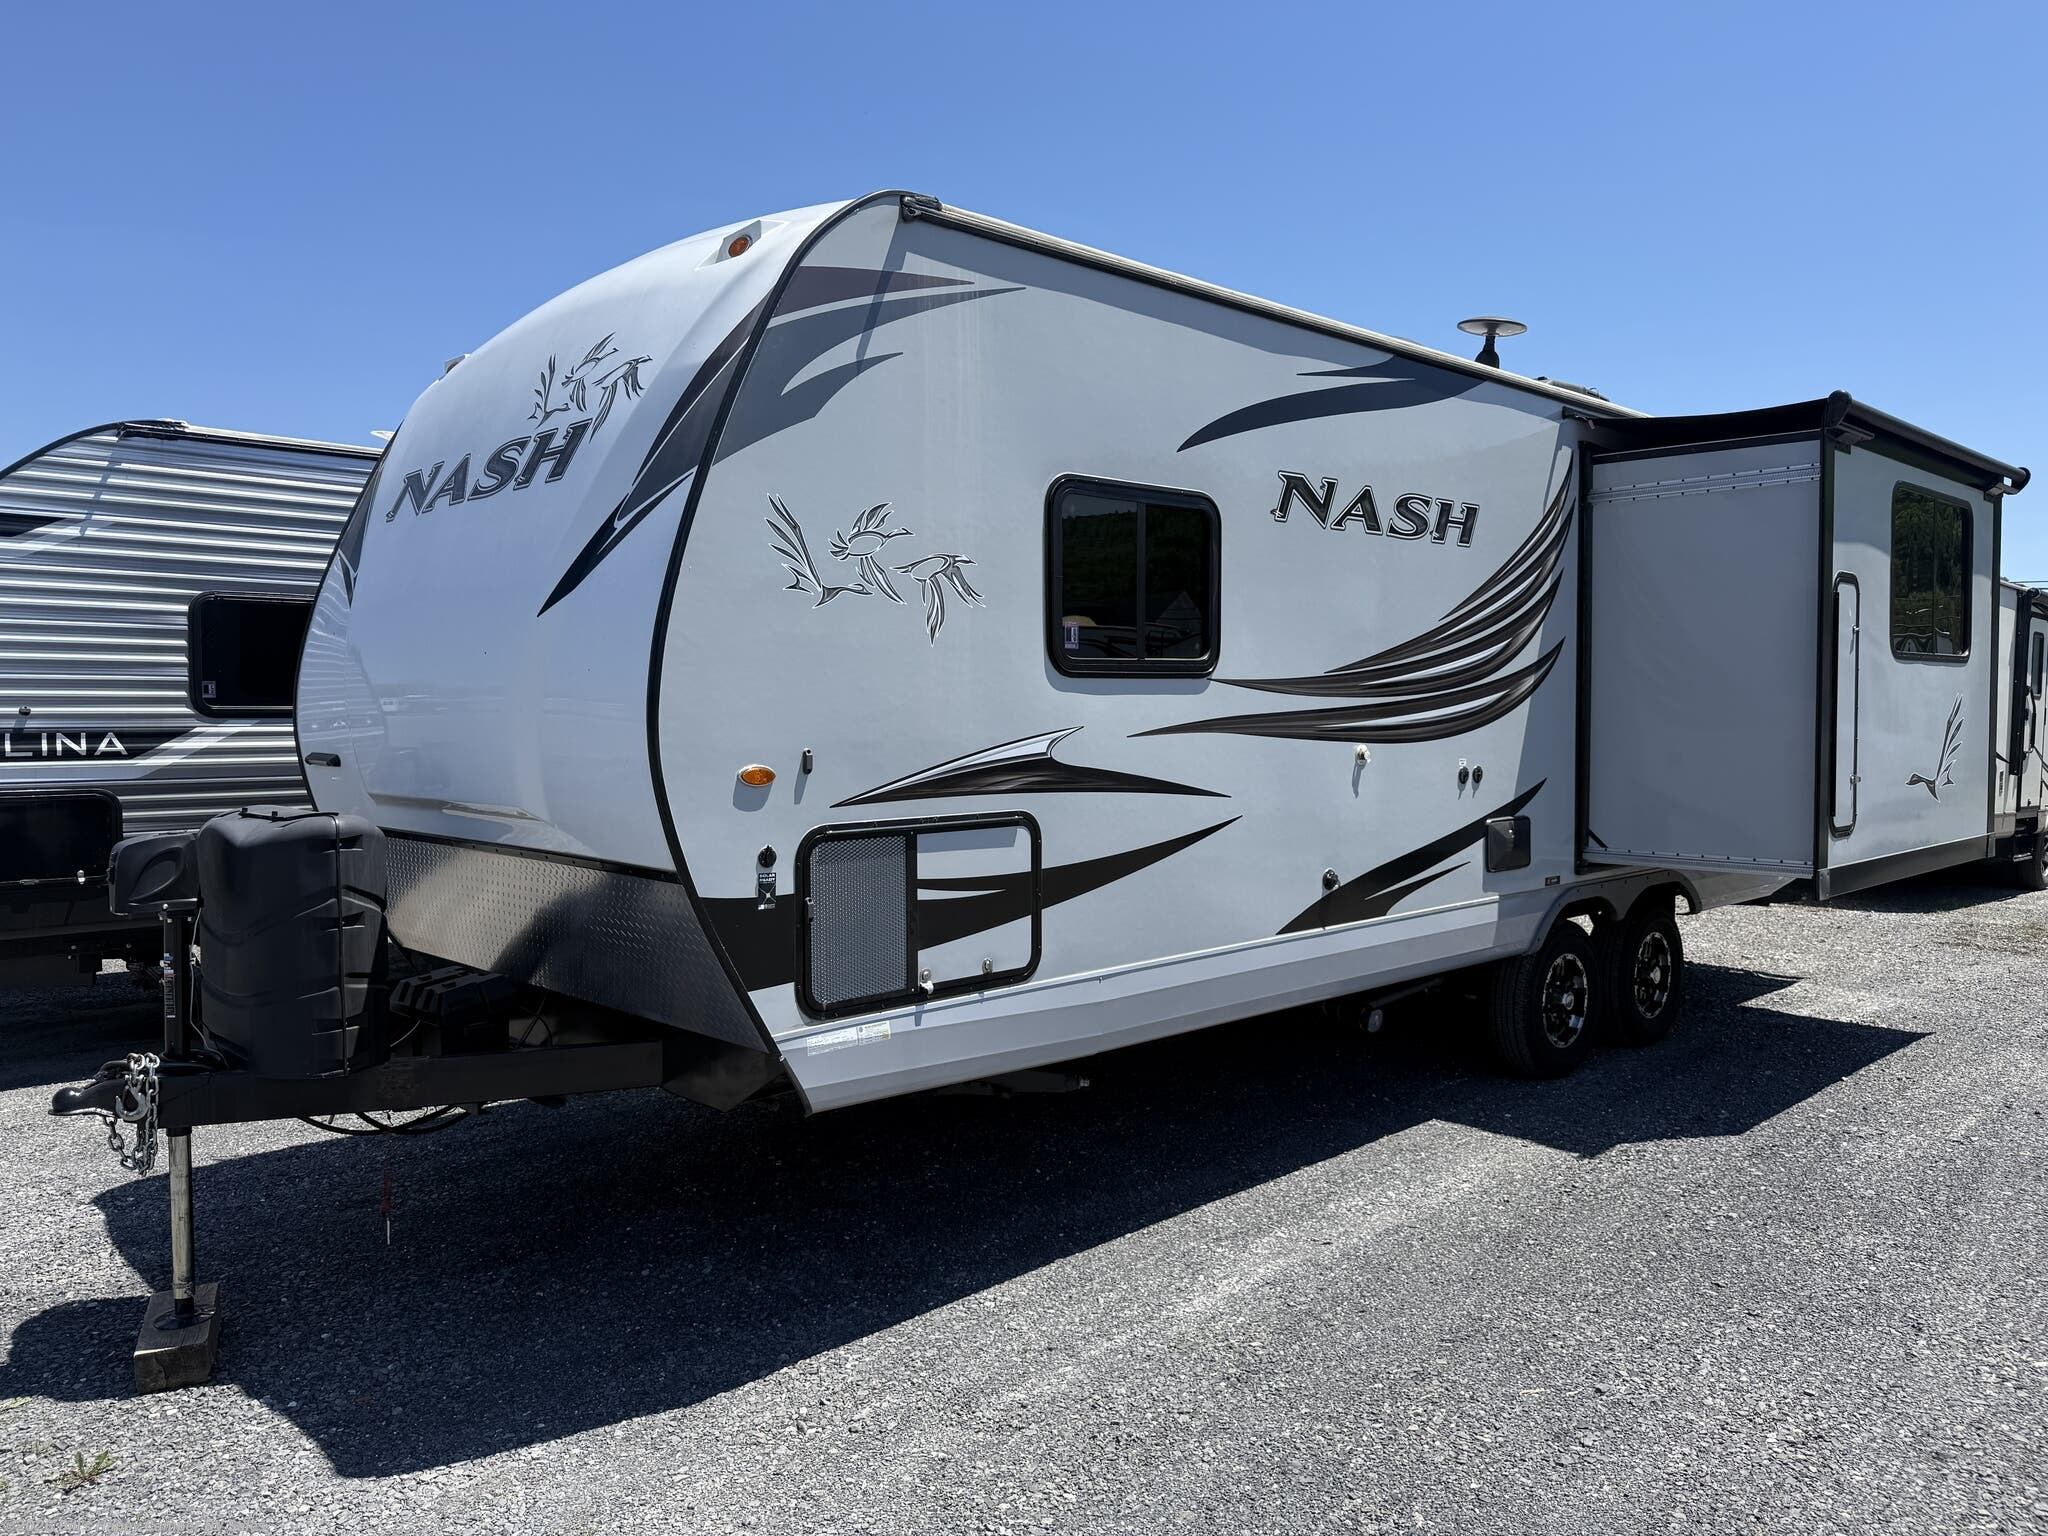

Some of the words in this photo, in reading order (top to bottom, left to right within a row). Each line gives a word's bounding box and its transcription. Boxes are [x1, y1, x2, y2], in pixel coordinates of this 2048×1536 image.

[385, 417, 593, 523] NASH
[1270, 469, 1480, 548] NASH
[4, 732, 128, 757] LINA
